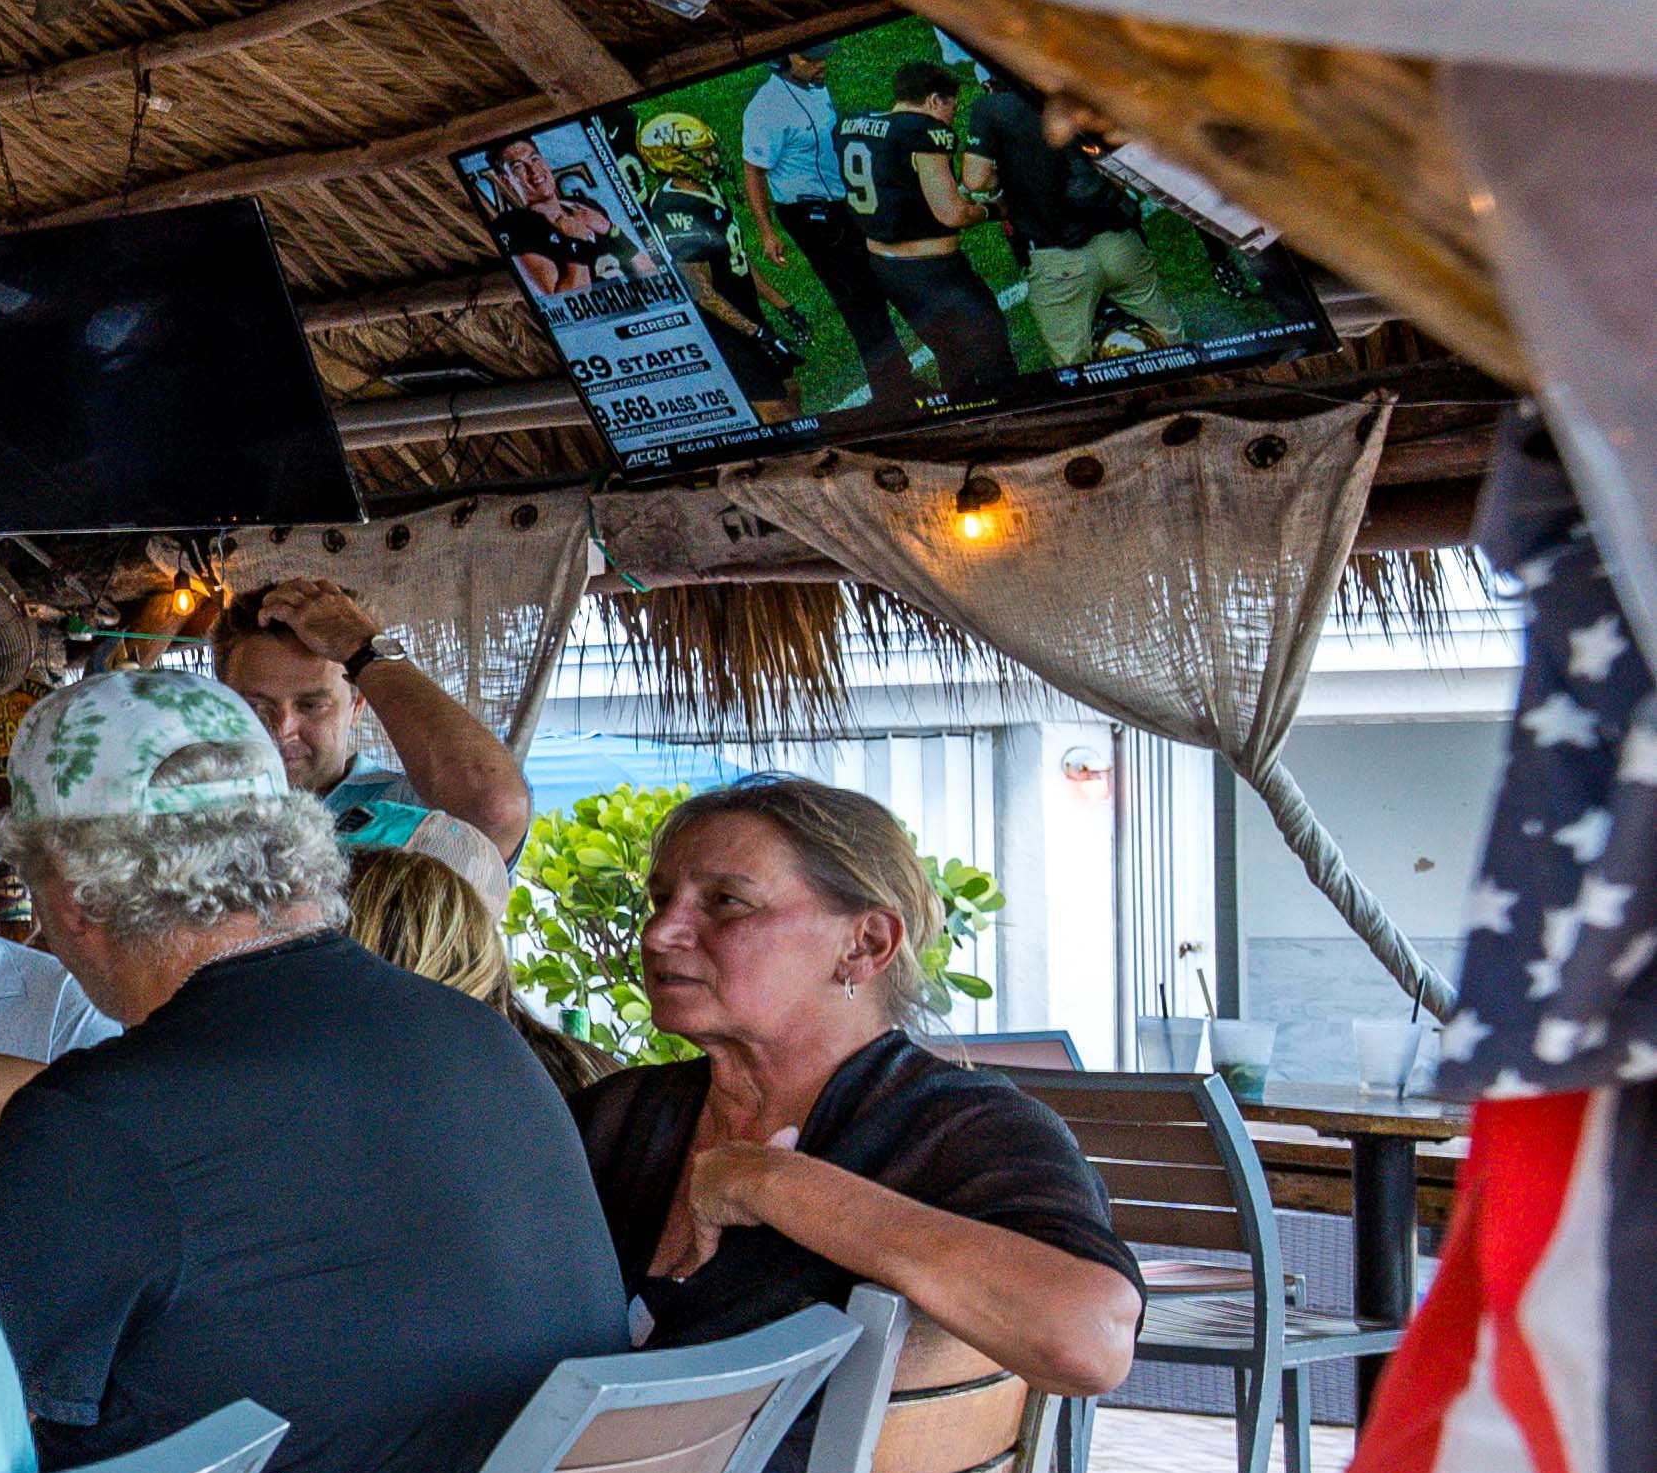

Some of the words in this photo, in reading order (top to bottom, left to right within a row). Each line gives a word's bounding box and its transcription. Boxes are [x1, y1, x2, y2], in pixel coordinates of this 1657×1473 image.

[843, 141, 878, 215] 9
[628, 315, 685, 336] CAREER
[570, 355, 612, 385] 39
[617, 342, 704, 376] STARTS
[1082, 365, 1130, 385] TITANS
[1137, 352, 1198, 377] DOLPHINS
[594, 395, 657, 429] 9,568
[659, 394, 695, 417] PASS
[695, 388, 730, 408] YDS
[722, 430, 760, 446] Florida
[791, 418, 821, 433] SMU
[626, 447, 670, 468] ACCN
